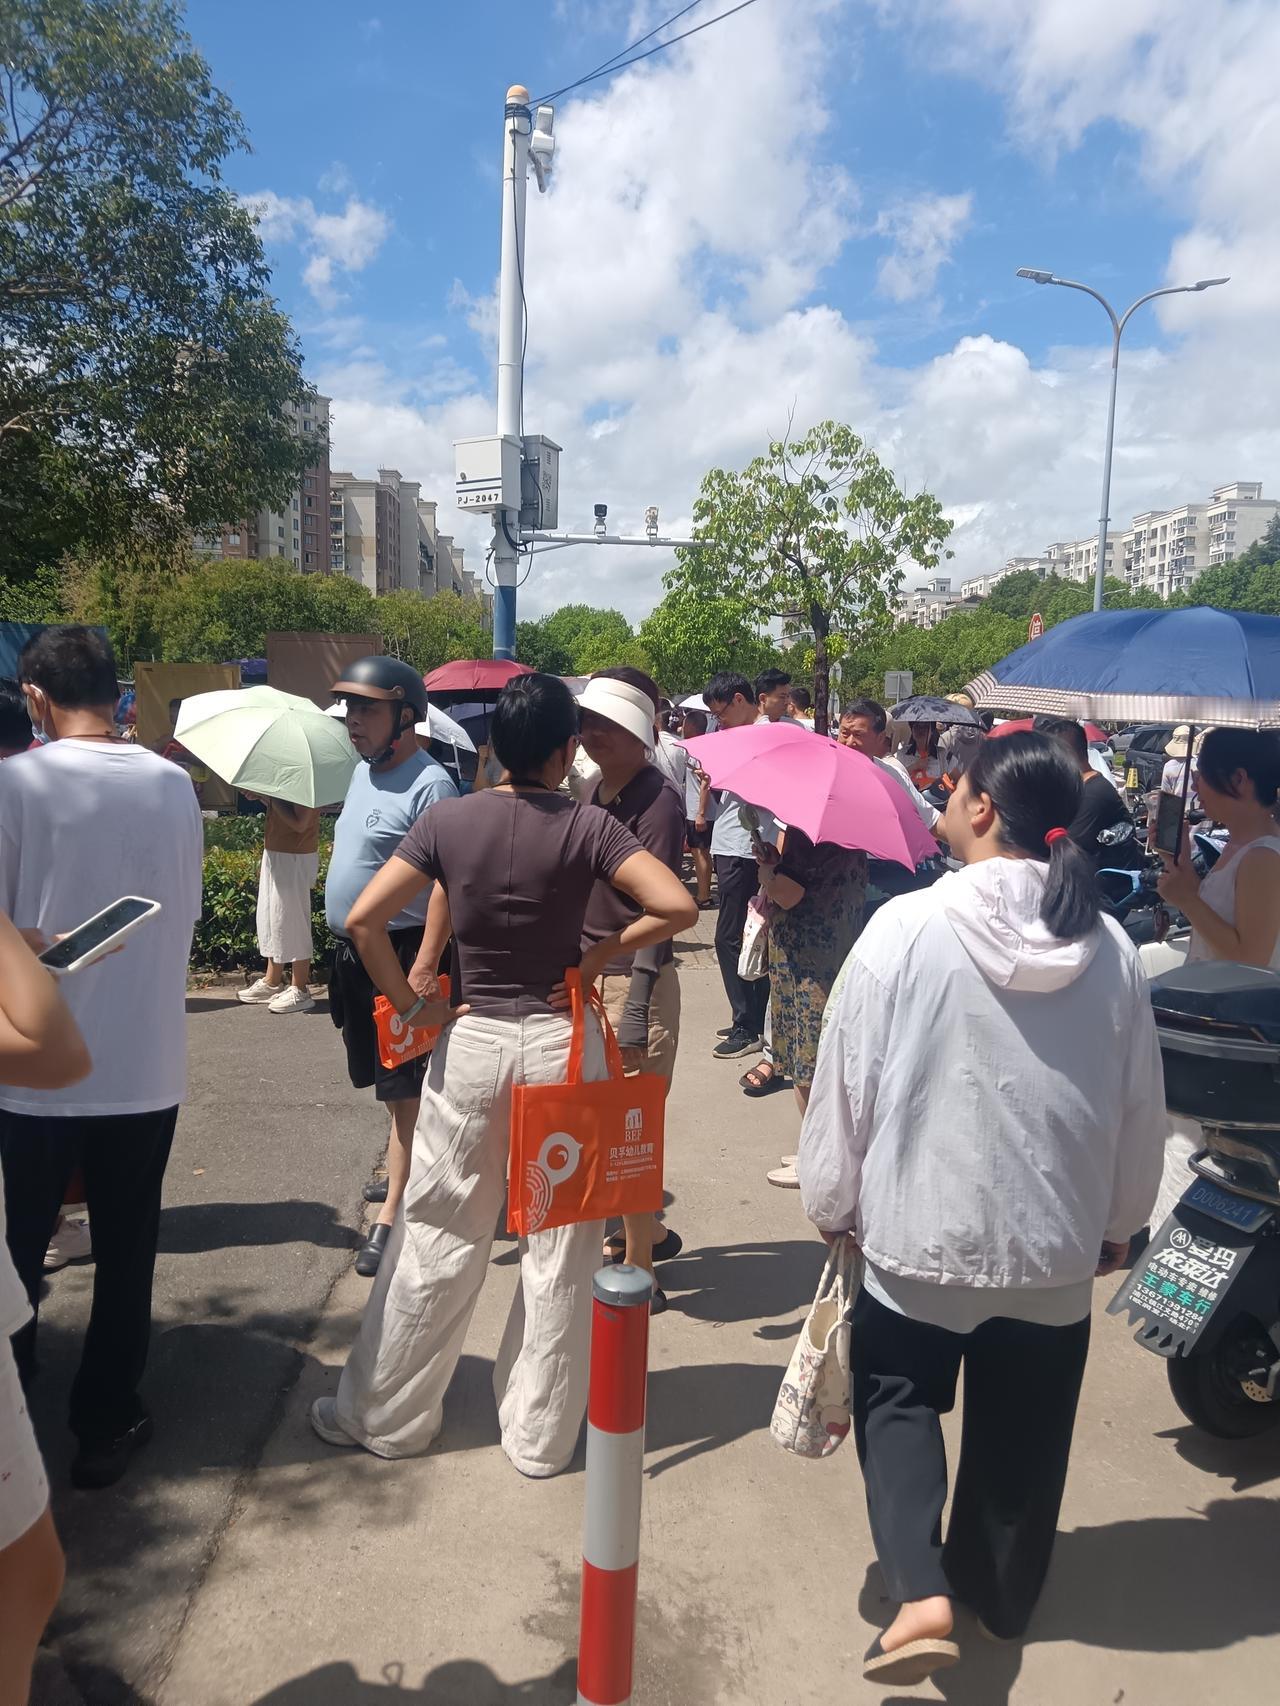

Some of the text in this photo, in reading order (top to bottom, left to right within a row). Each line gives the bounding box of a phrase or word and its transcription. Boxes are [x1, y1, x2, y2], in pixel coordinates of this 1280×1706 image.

[457, 493, 499, 505] PJ-2047
[625, 1129, 642, 1142] BEF
[1153, 1248, 1229, 1289] 依莱达
[1140, 1271, 1212, 1315] 王蒙车行
